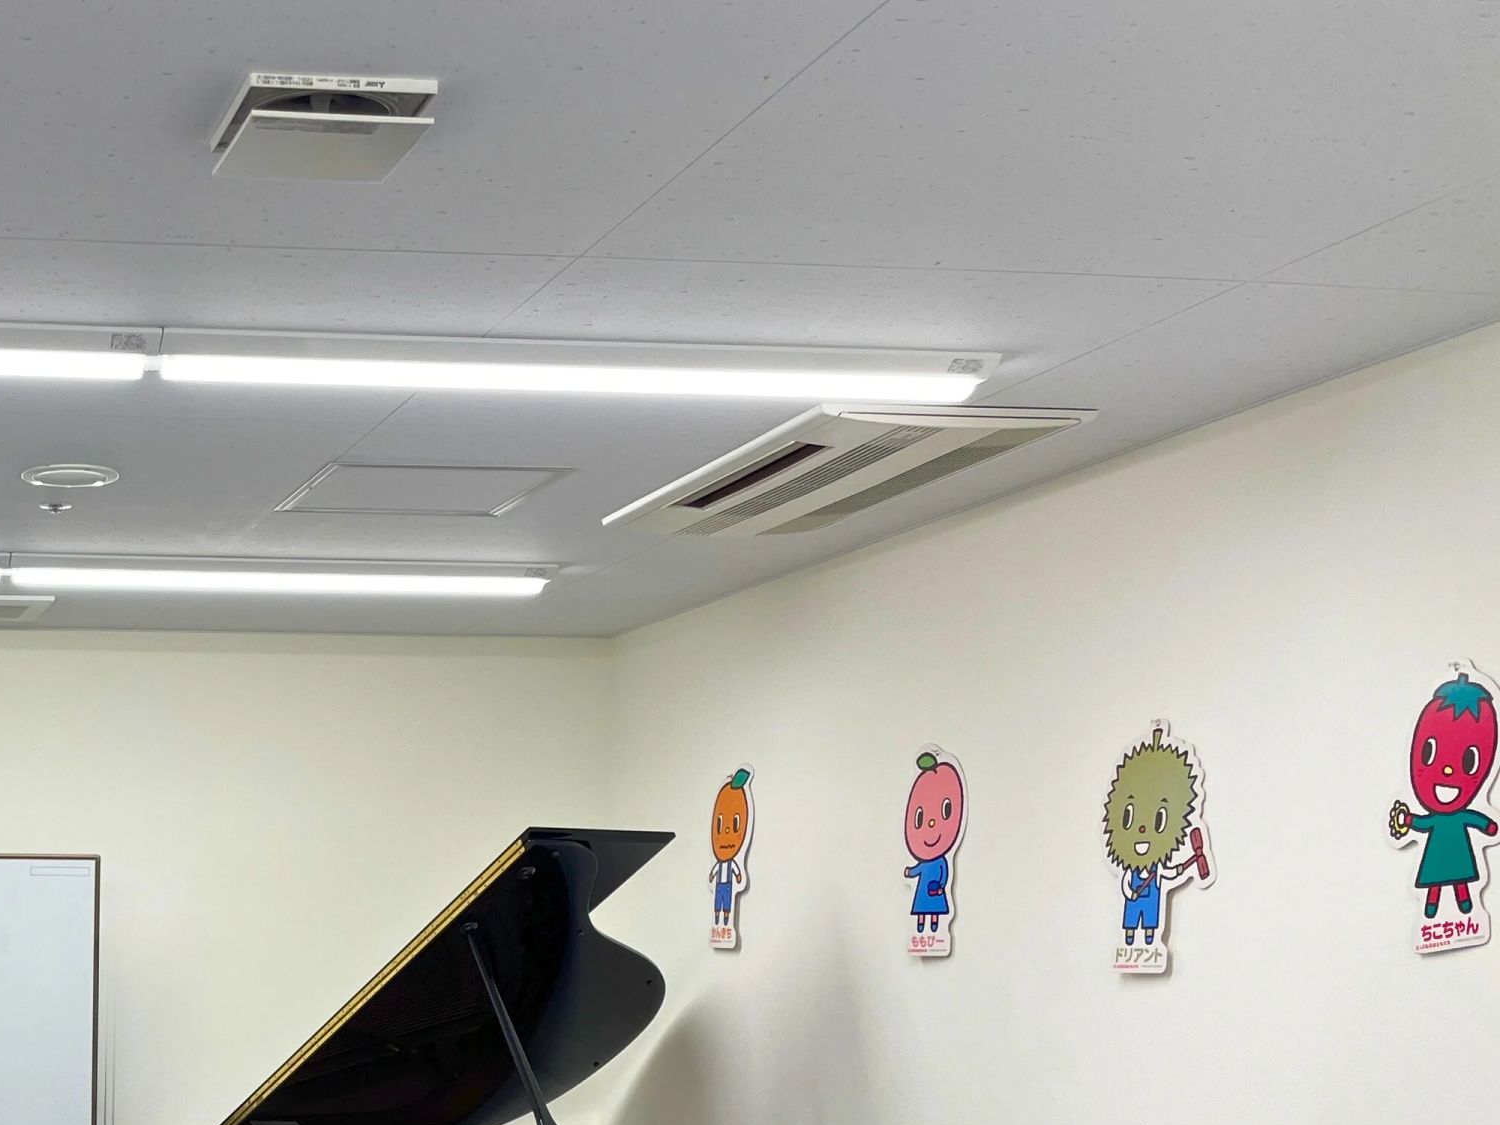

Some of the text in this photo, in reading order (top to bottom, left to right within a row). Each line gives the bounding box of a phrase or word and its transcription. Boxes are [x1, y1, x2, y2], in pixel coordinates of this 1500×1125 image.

[1421, 917, 1479, 941] ちこちゃん
[1115, 947, 1163, 963] ドリアント
